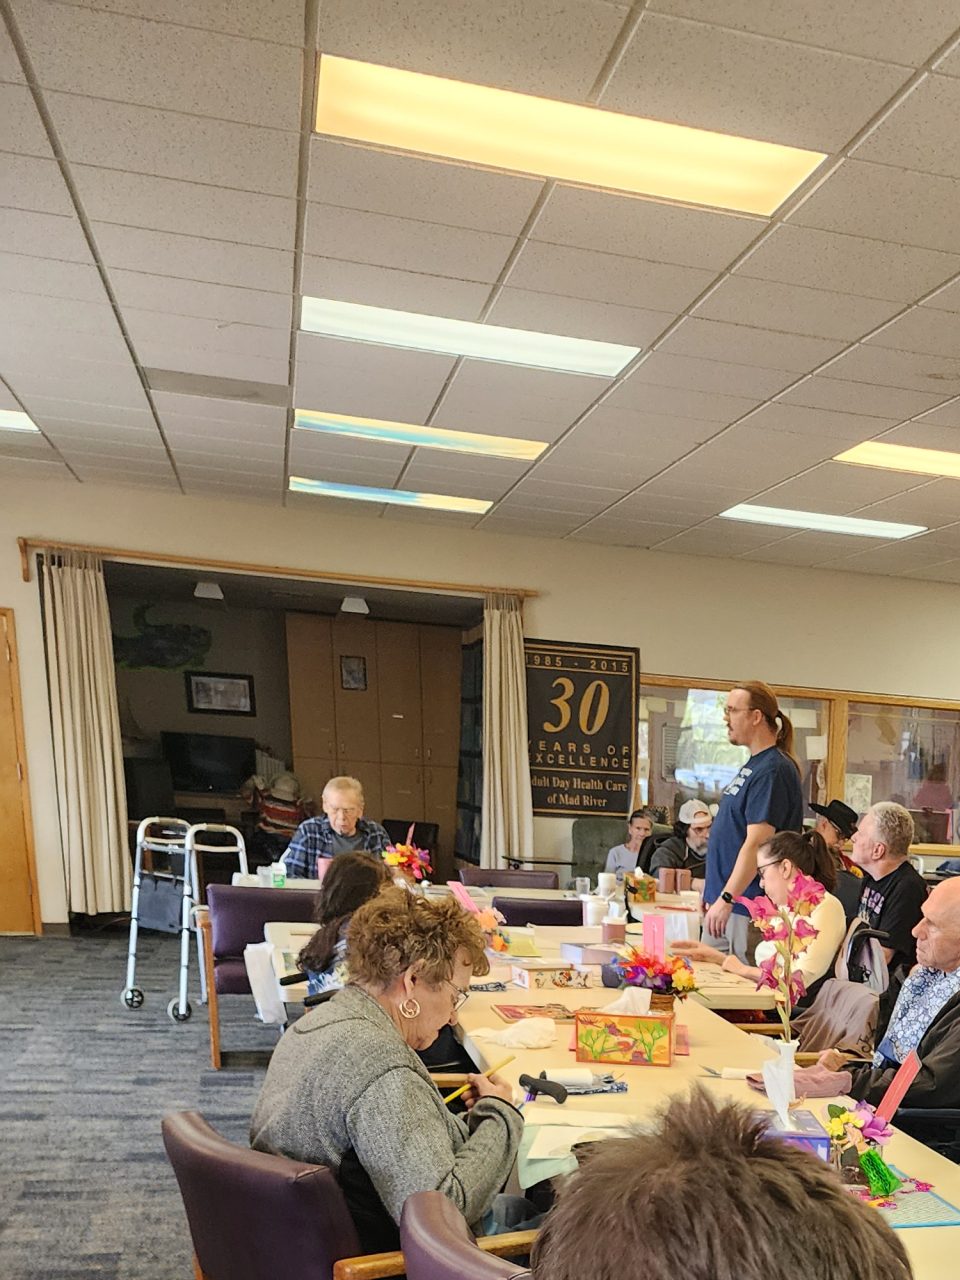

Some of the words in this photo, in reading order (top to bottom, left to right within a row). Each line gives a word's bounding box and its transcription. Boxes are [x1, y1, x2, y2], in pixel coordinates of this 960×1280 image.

[590, 660, 628, 672] 2015
[543, 677, 610, 735] 30
[529, 740, 591, 754] EARS
[607, 745, 630, 756] OF
[531, 775, 550, 787] dult
[552, 776, 571, 791] Day
[573, 777, 603, 790] Health
[605, 780, 628, 792] Care
[547, 793, 558, 805] of
[559, 794, 581, 806] Mad
[582, 795, 608, 807] River
